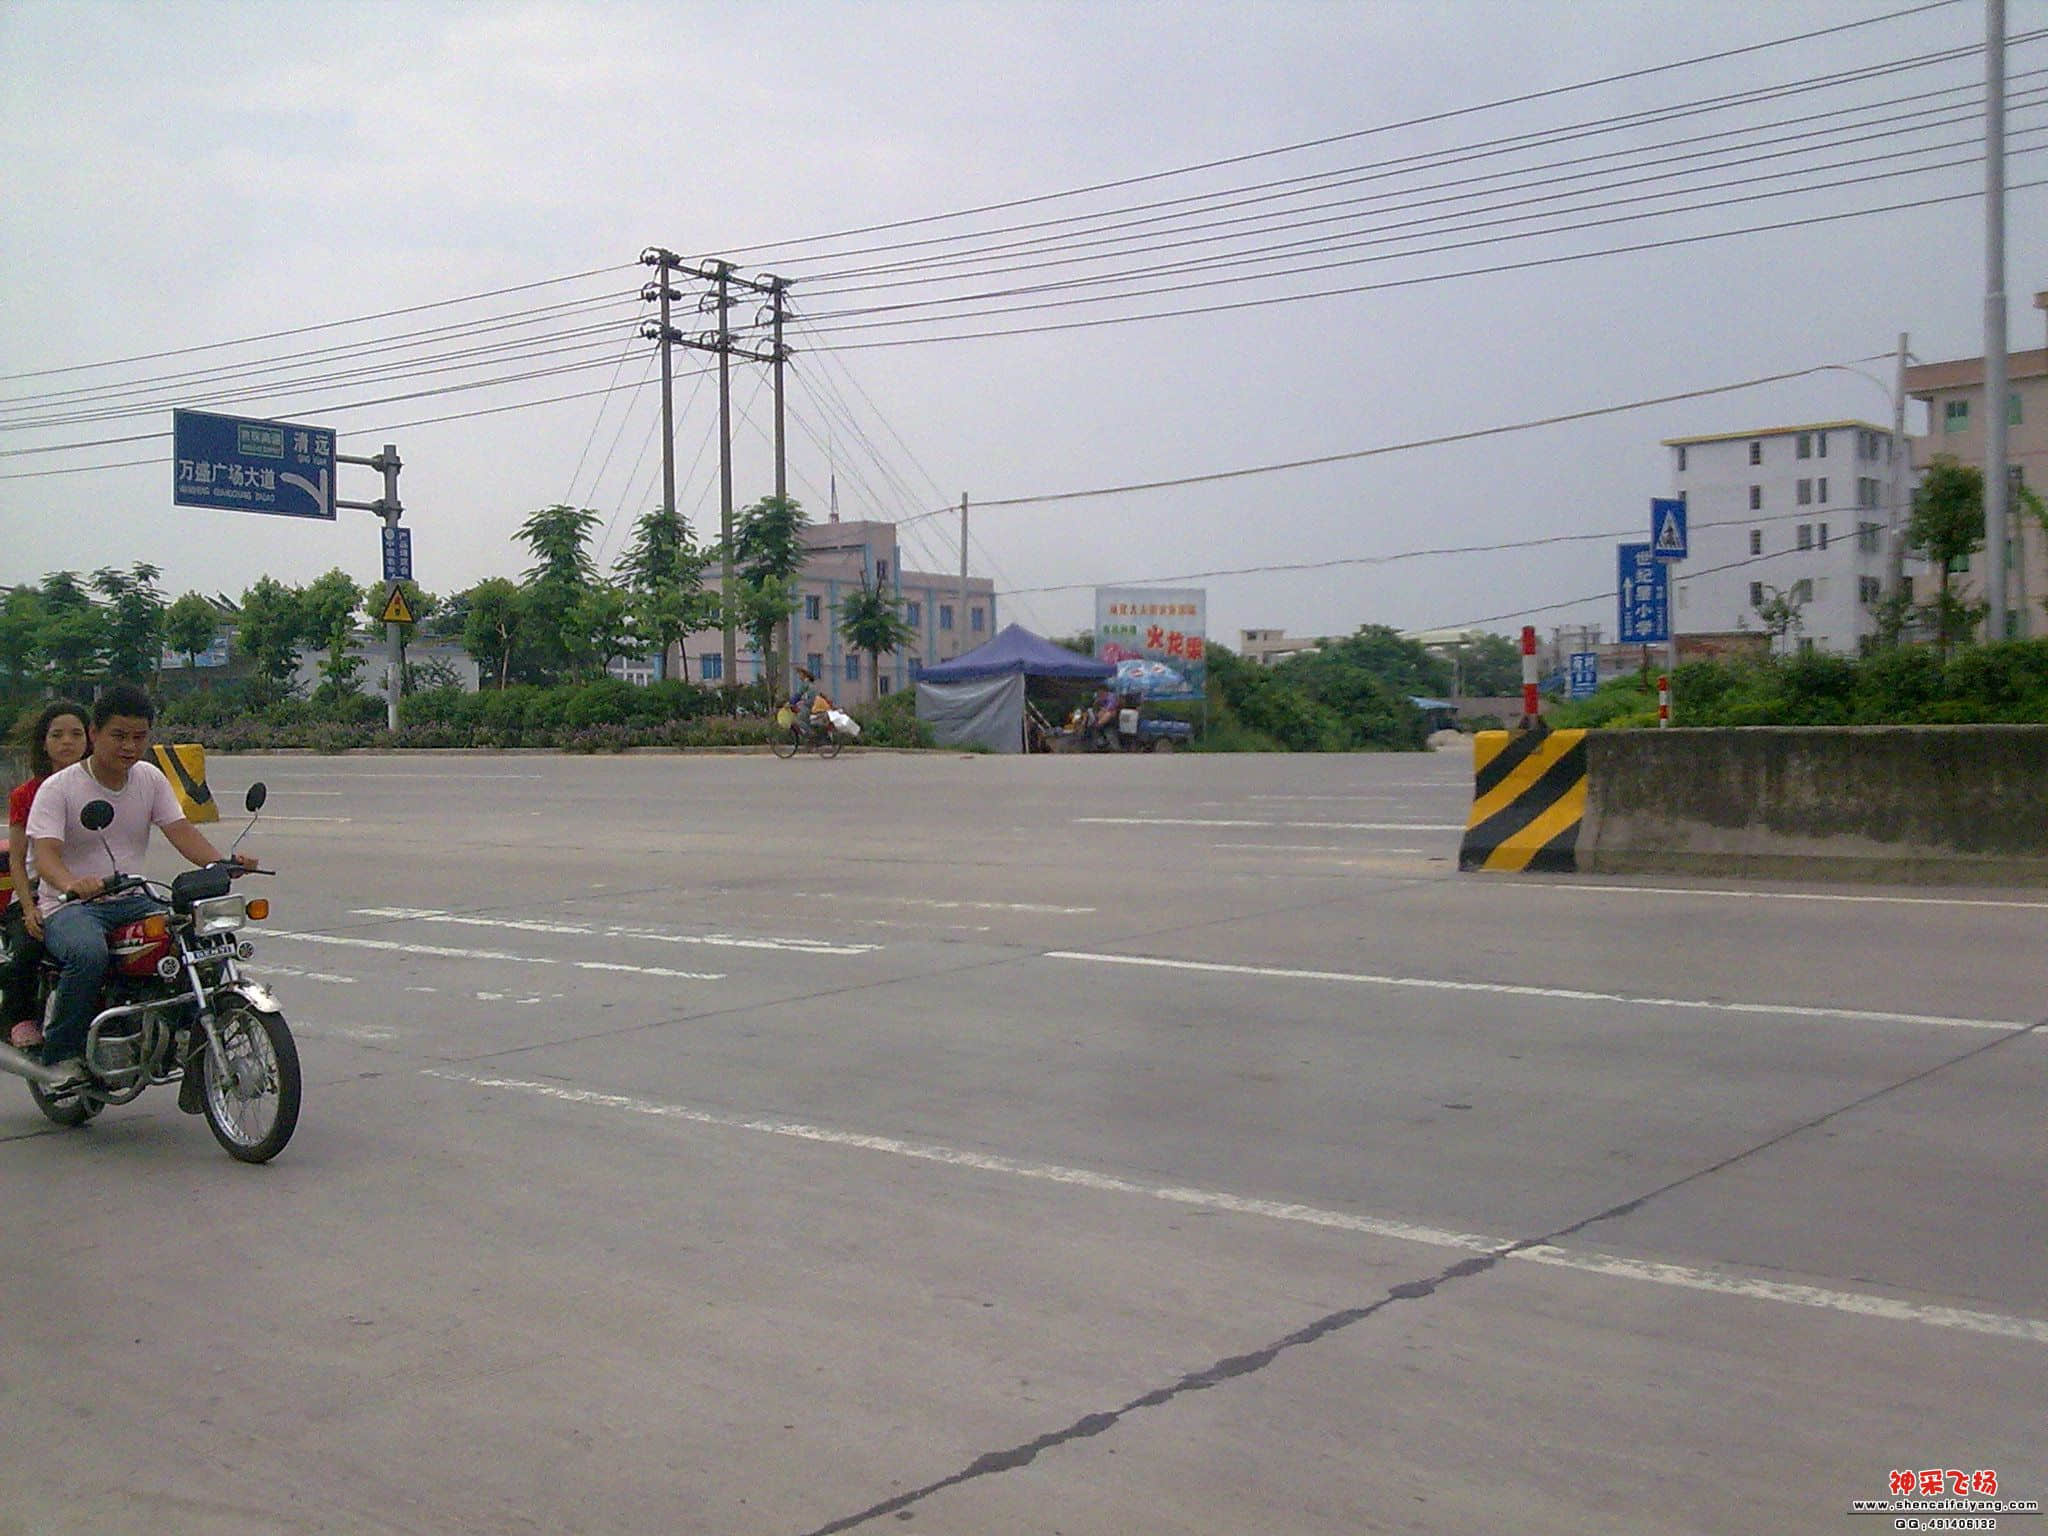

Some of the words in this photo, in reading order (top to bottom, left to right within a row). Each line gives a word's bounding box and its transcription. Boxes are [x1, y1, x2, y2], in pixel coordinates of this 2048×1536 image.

[178, 459, 276, 490] 万盛广场大道
